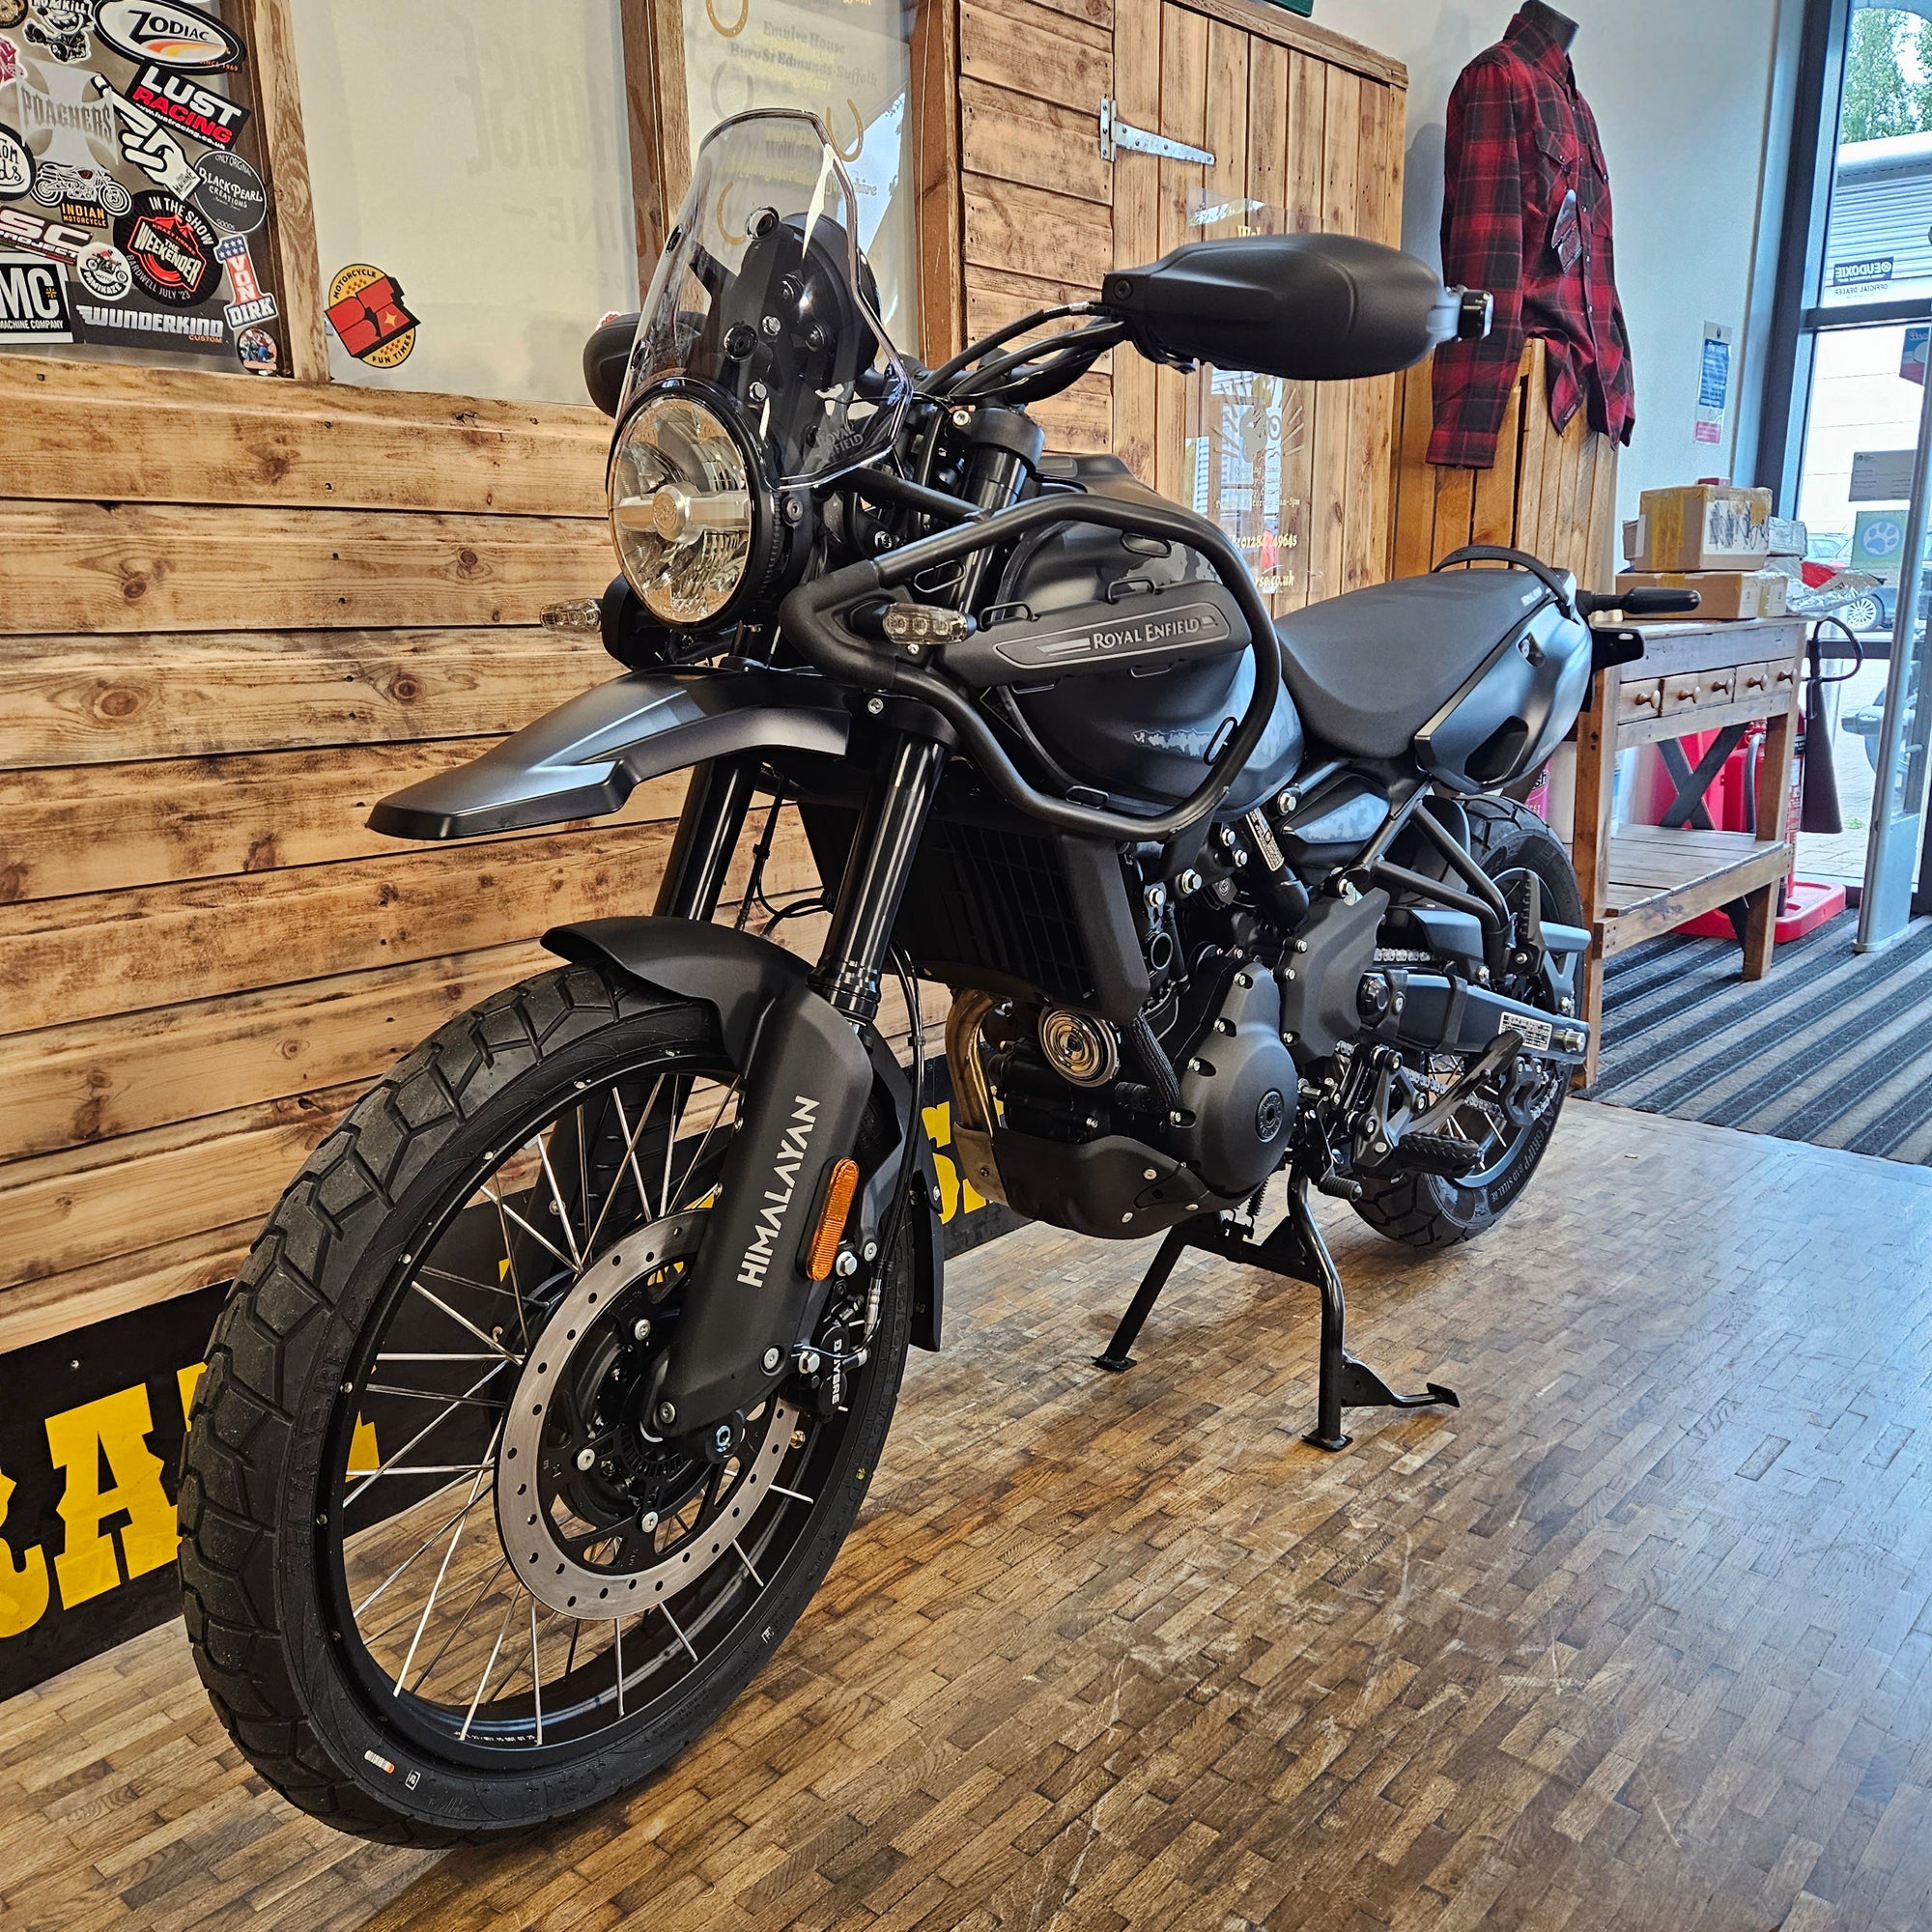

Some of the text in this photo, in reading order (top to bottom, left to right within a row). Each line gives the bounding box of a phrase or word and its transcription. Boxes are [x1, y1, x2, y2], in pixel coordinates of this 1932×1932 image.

[128, 9, 210, 44] ZODIAC
[221, 63, 239, 71] 1969
[140, 65, 242, 126] LUST
[20, 84, 113, 145] POACHERS
[132, 86, 233, 144] RACING
[199, 166, 263, 202] BLACK PEARL
[209, 185, 248, 209] CREATIONS
[61, 203, 105, 219] INDIAN
[63, 214, 107, 227] MOTORCYCLE
[148, 196, 214, 245] IN THE SHOW
[216, 218, 236, 231] GOODS
[134, 221, 203, 286] WEEKENDER
[164, 238, 181, 251] THE
[127, 254, 156, 292] BARDWELL
[158, 287, 177, 299] JULY
[227, 255, 256, 304] VON
[333, 269, 377, 299] MOTORCYCLE
[30, 320, 64, 329] COMPANY
[77, 305, 224, 337] WUNDERKIND
[228, 297, 275, 327] DIRK
[188, 334, 222, 344] CUSTOM
[392, 334, 412, 360] TIMES
[1094, 617, 1201, 650] ROYAL ENFIELD
[736, 1094, 821, 1288] HIMALAYAN
